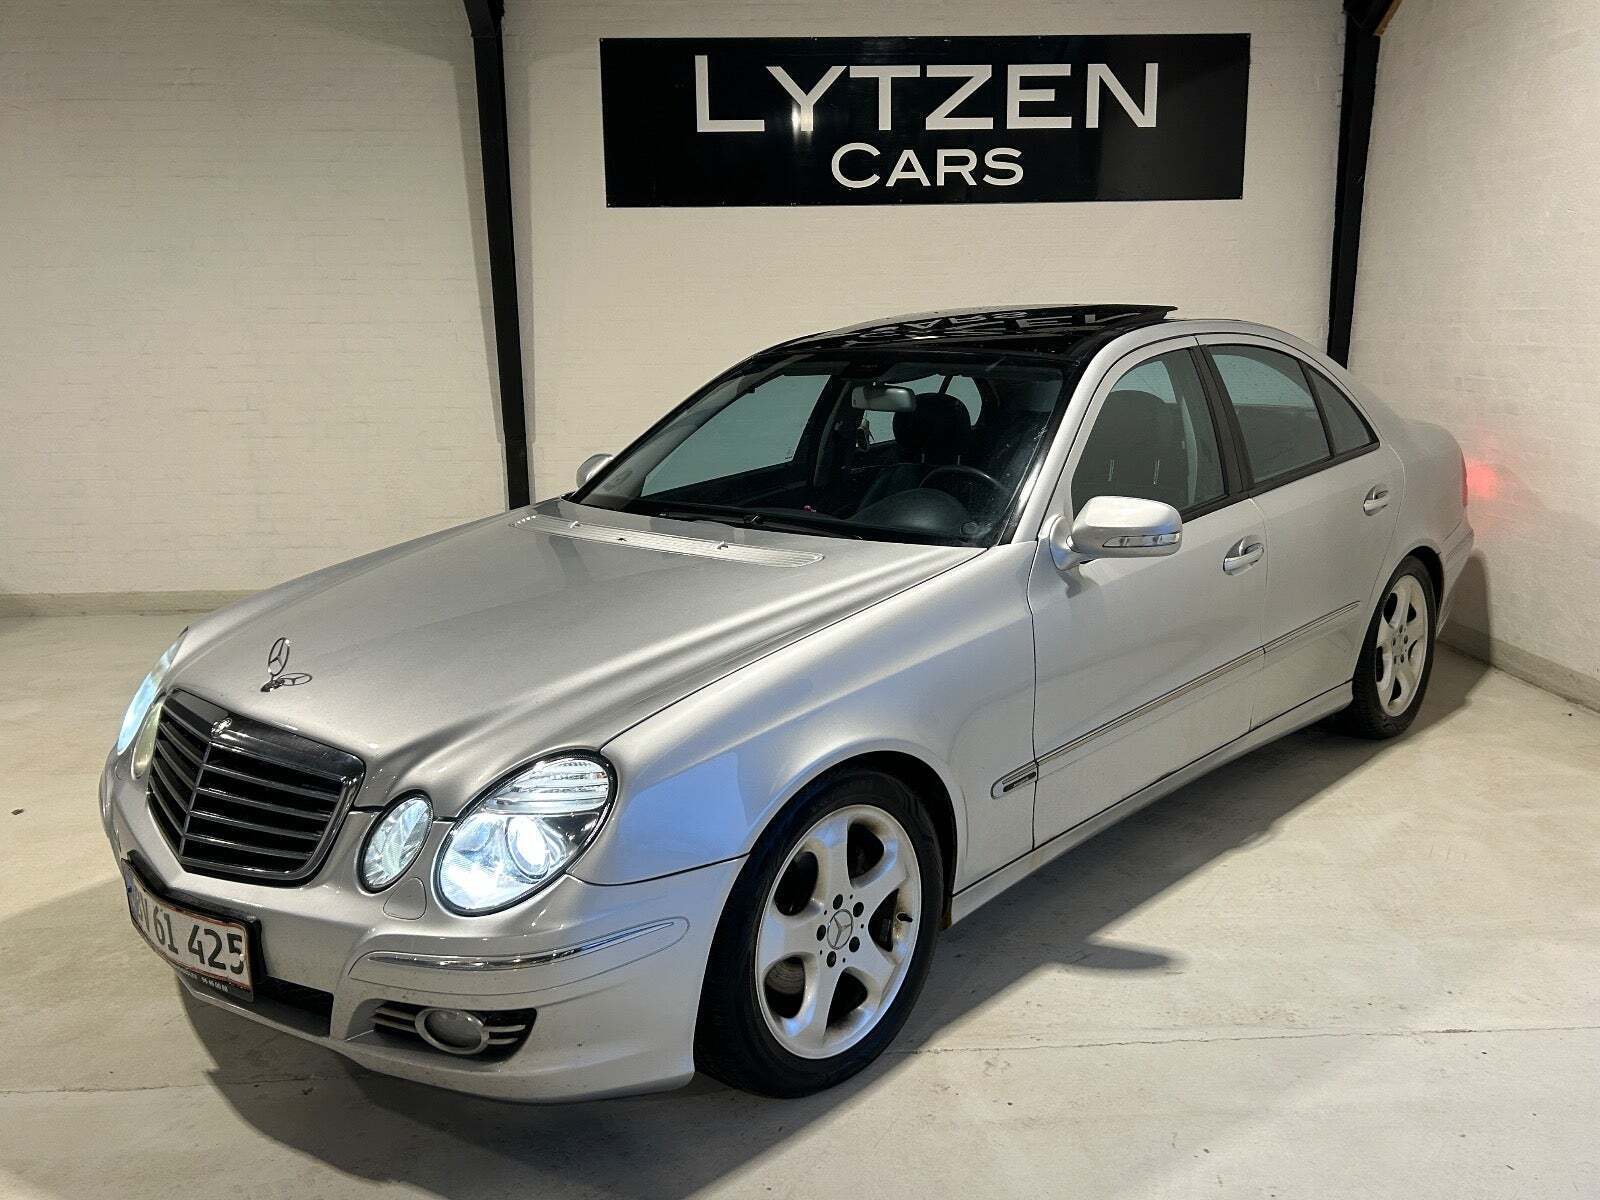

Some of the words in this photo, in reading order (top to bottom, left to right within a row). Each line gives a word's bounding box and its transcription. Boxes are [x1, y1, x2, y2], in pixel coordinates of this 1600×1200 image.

[694, 55, 1159, 134] LYTZEN
[831, 142, 1024, 189] CARS
[153, 905, 179, 955] 61
[187, 924, 245, 975] 425
